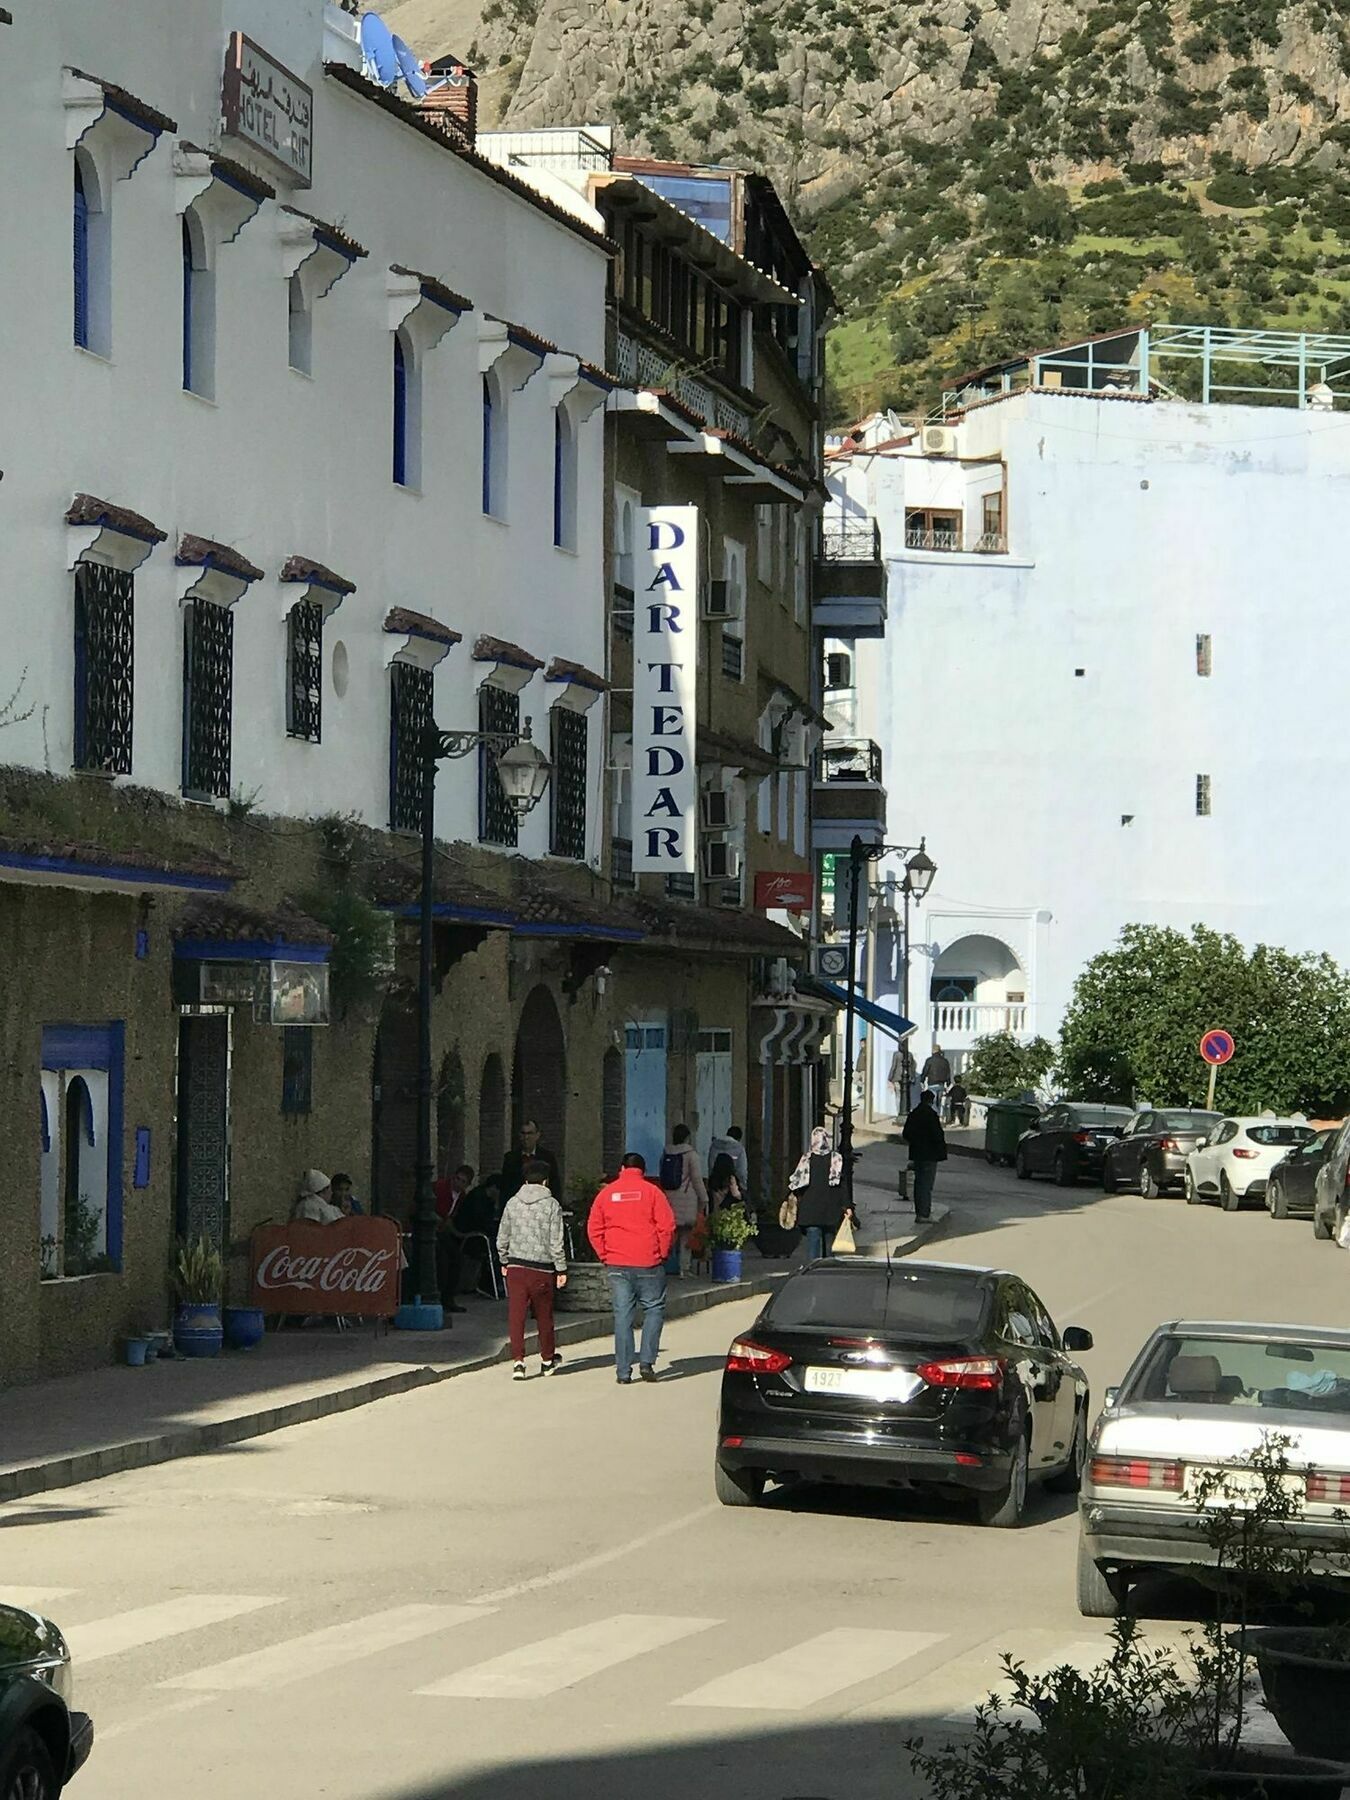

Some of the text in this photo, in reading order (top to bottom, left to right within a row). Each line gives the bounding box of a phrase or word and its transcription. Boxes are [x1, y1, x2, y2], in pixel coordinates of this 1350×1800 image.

[239, 93, 280, 150] HOTEL
[644, 520, 686, 634] DAR
[256, 1245, 395, 1294] Coca-Cola
